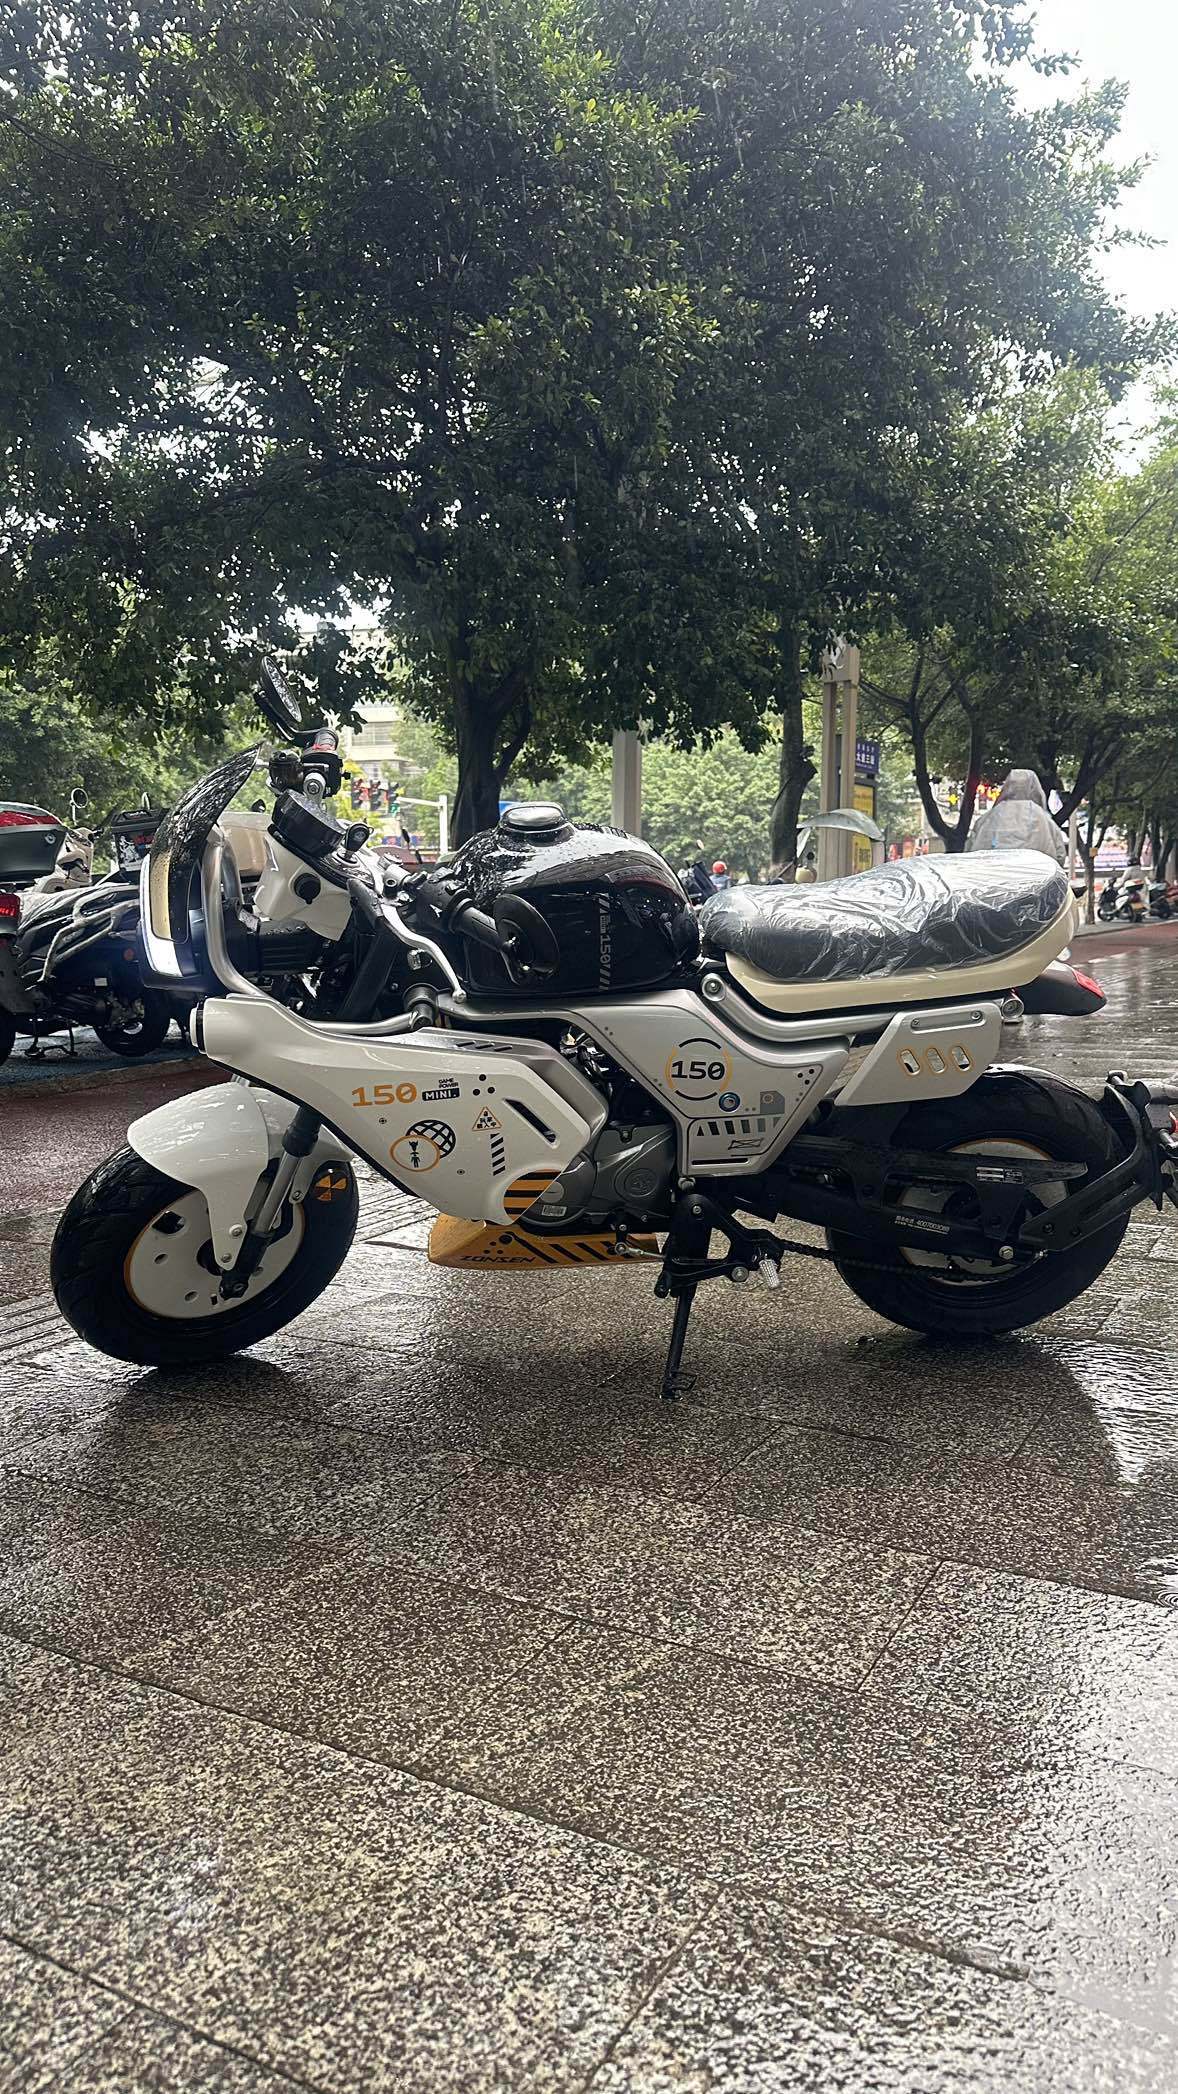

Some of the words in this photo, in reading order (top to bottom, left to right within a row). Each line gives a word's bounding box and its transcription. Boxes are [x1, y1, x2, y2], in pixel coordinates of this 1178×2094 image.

[600, 935, 612, 964] 150
[671, 1060, 725, 1080] 150
[351, 1082, 417, 1107] 150
[459, 1254, 536, 1264] ZONSEN
